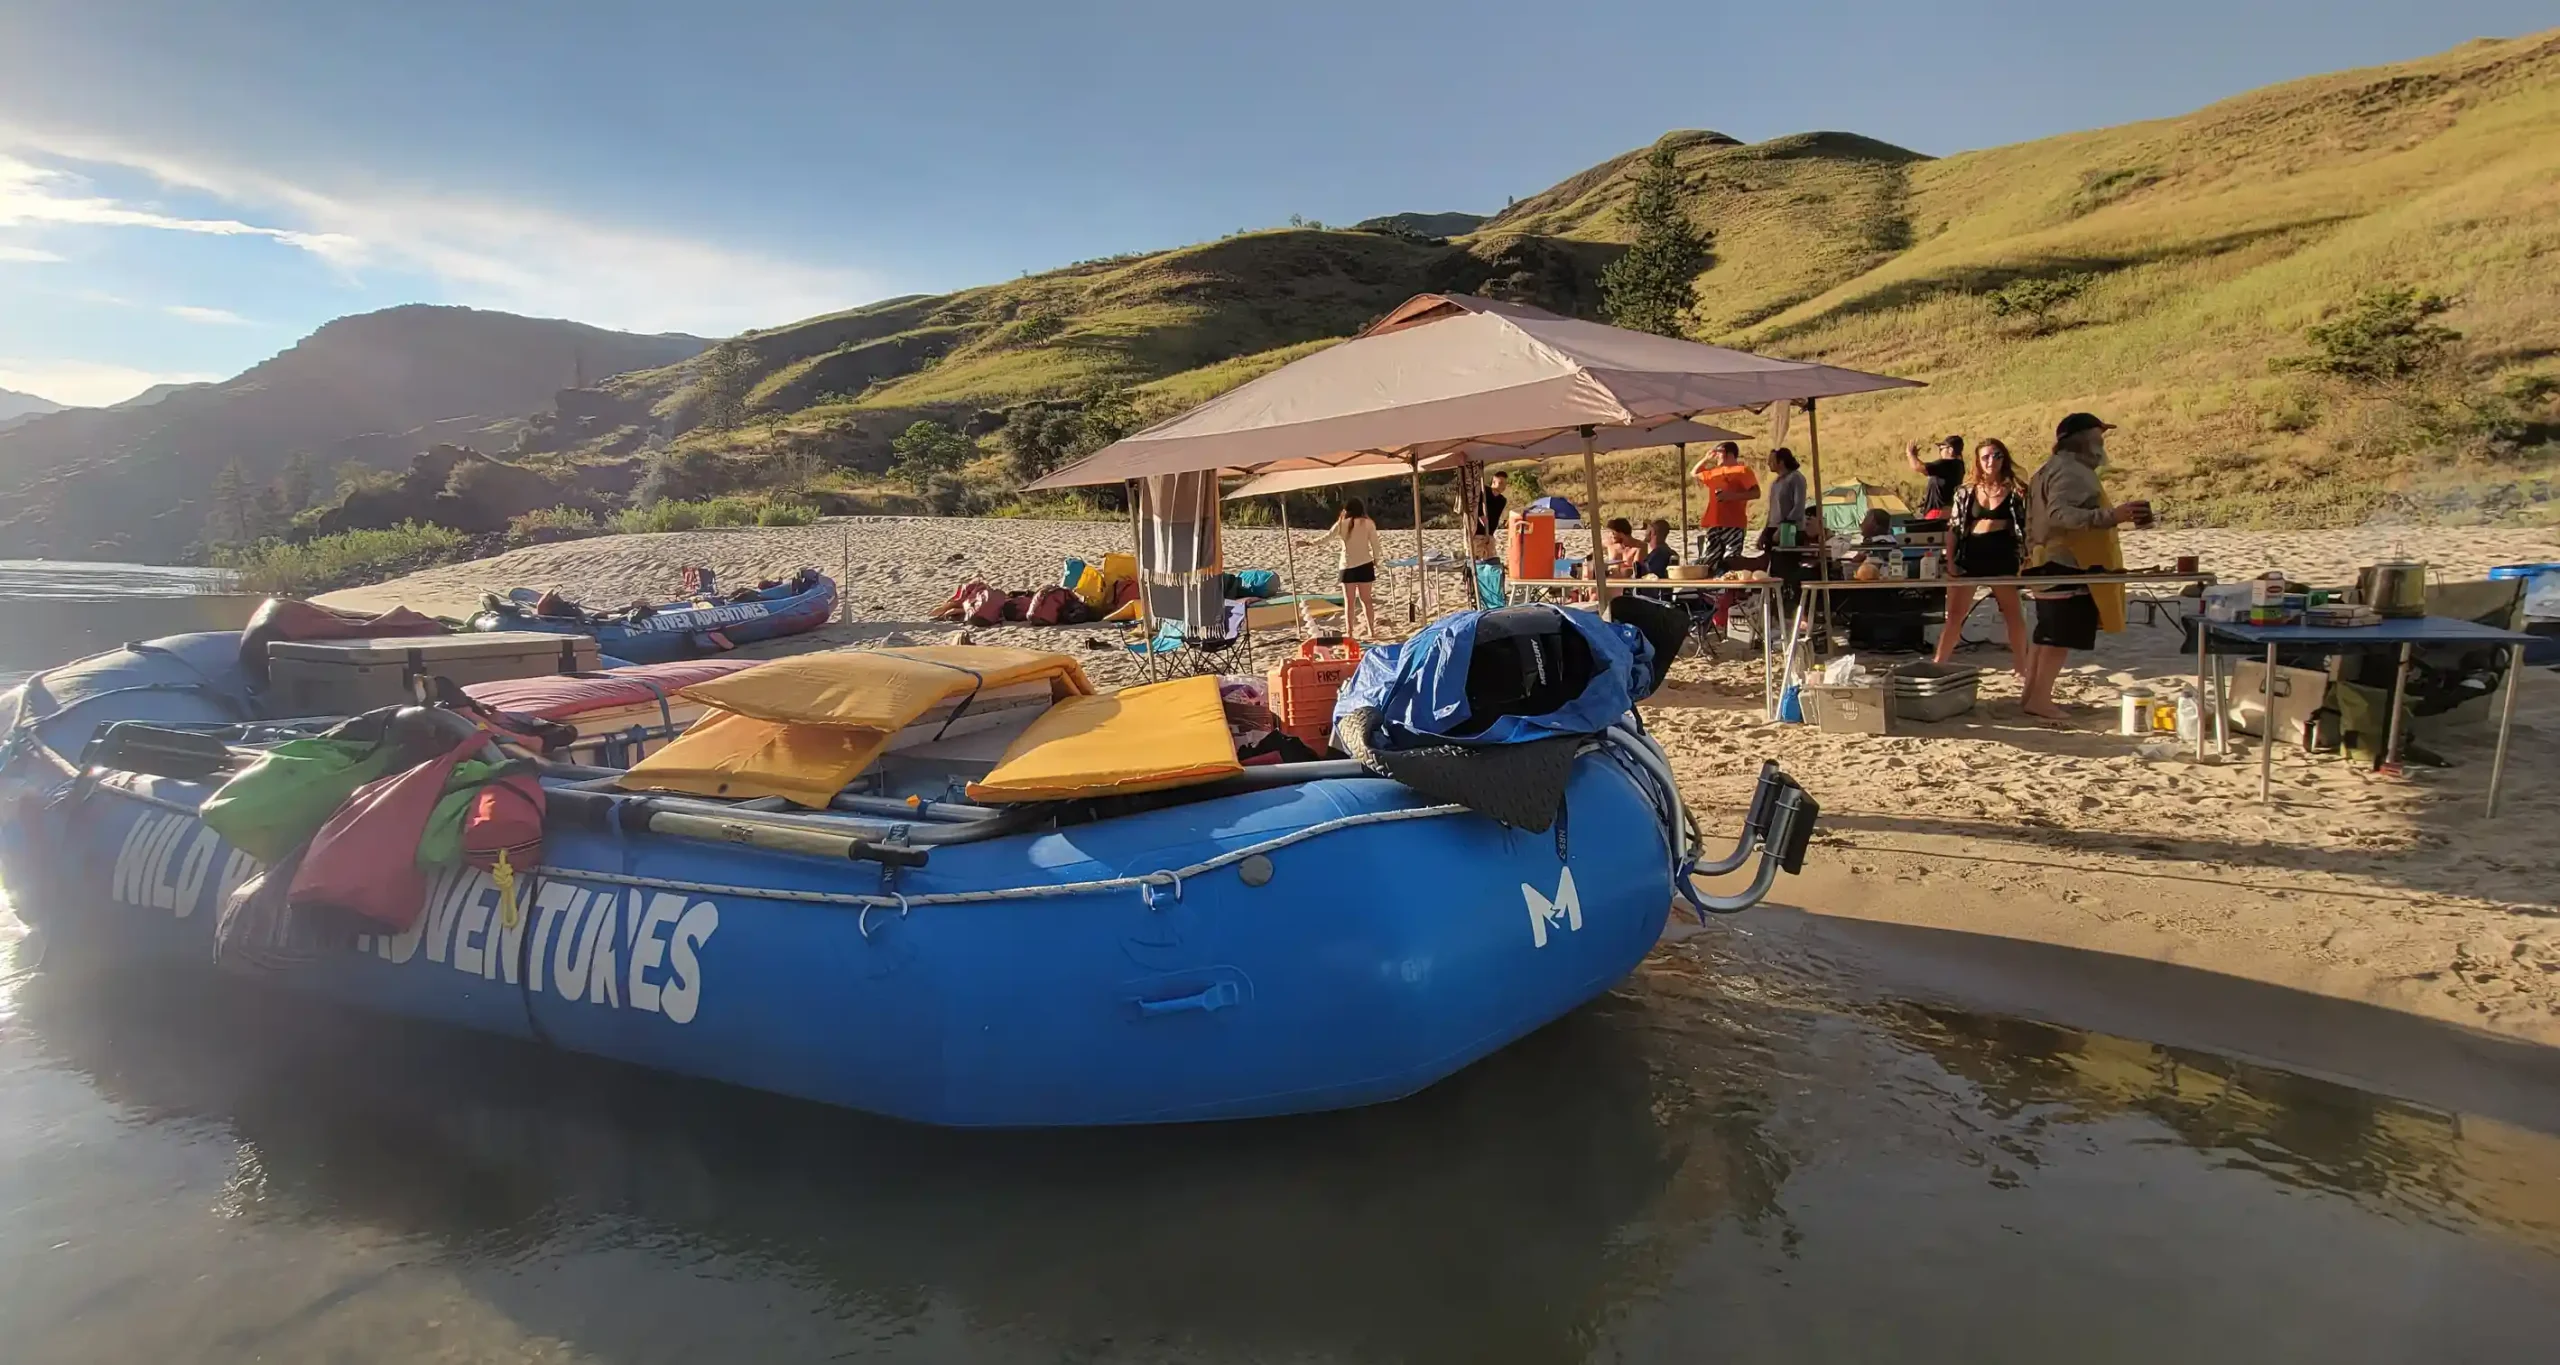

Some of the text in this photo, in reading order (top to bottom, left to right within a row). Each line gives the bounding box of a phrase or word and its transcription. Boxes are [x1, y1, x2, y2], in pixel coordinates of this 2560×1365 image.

[655, 613, 694, 631] RIVER
[695, 603, 770, 625] ADVENTURES
[1316, 670, 1341, 682] FIRST
[1530, 638, 1547, 685] MERCURY
[112, 809, 220, 918] WILD
[357, 864, 719, 1024] VENTURES
